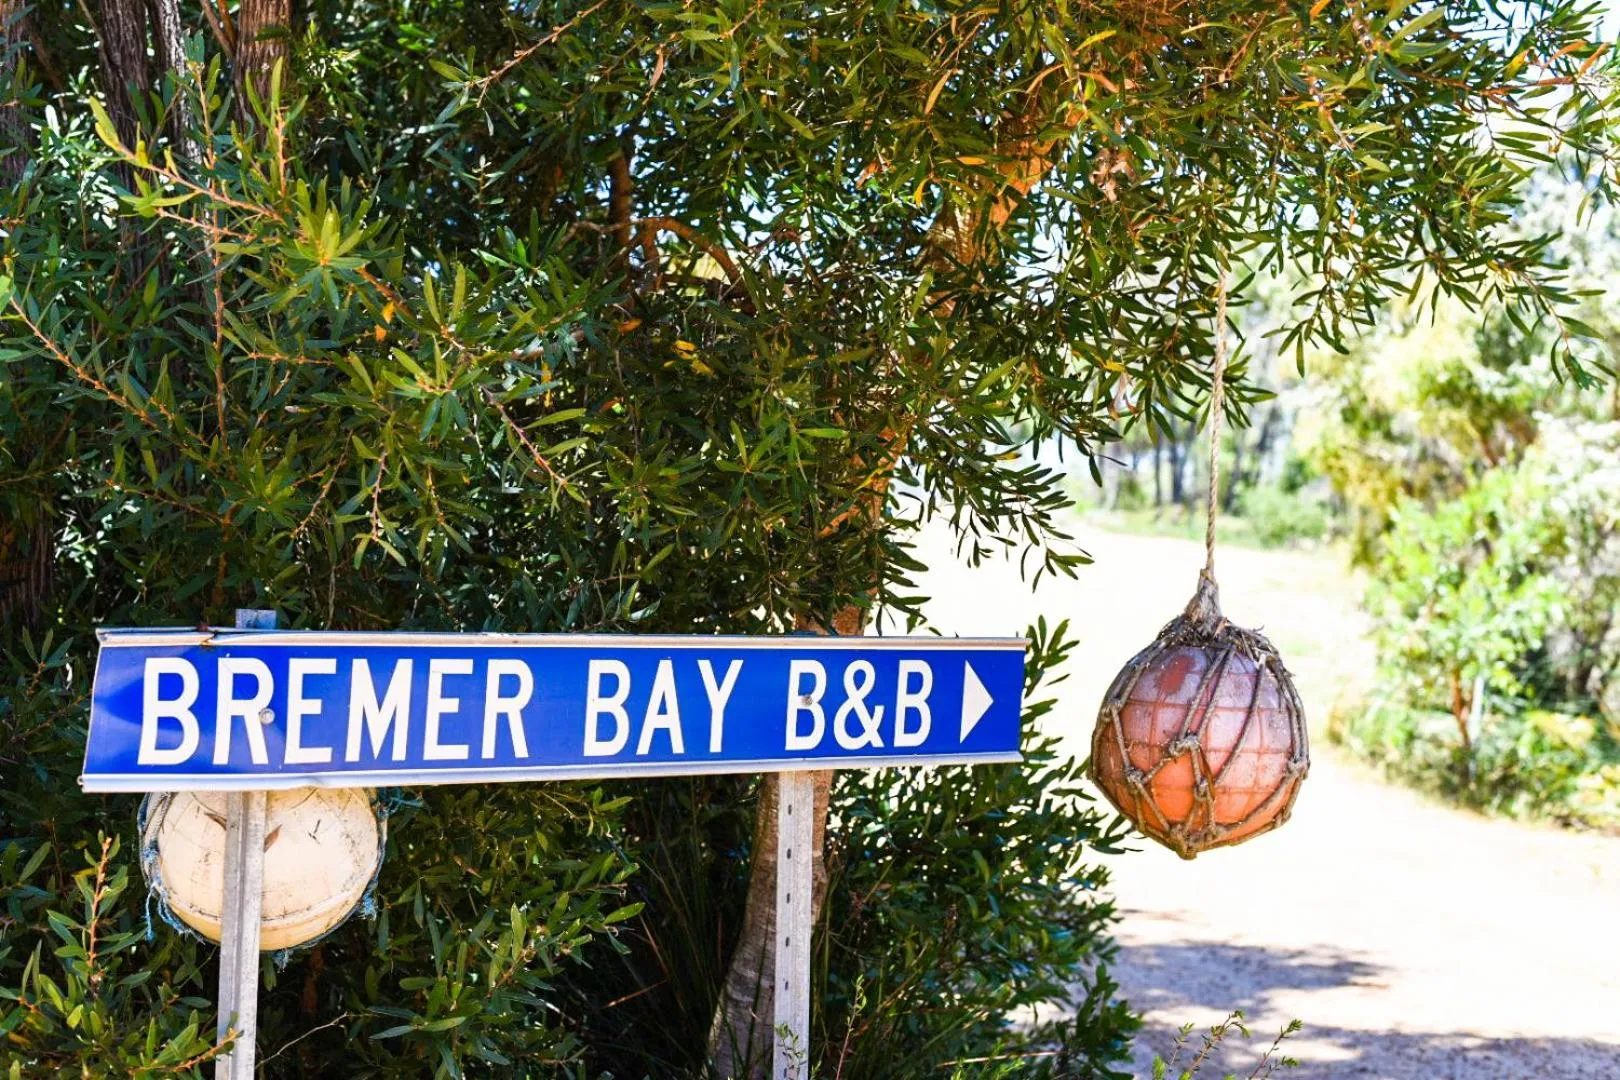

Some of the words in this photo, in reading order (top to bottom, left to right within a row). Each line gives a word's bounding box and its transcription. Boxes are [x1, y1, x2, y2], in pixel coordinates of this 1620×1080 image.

[137, 657, 534, 765] BREMER
[583, 659, 744, 757] BAY
[785, 659, 933, 751] B&B
